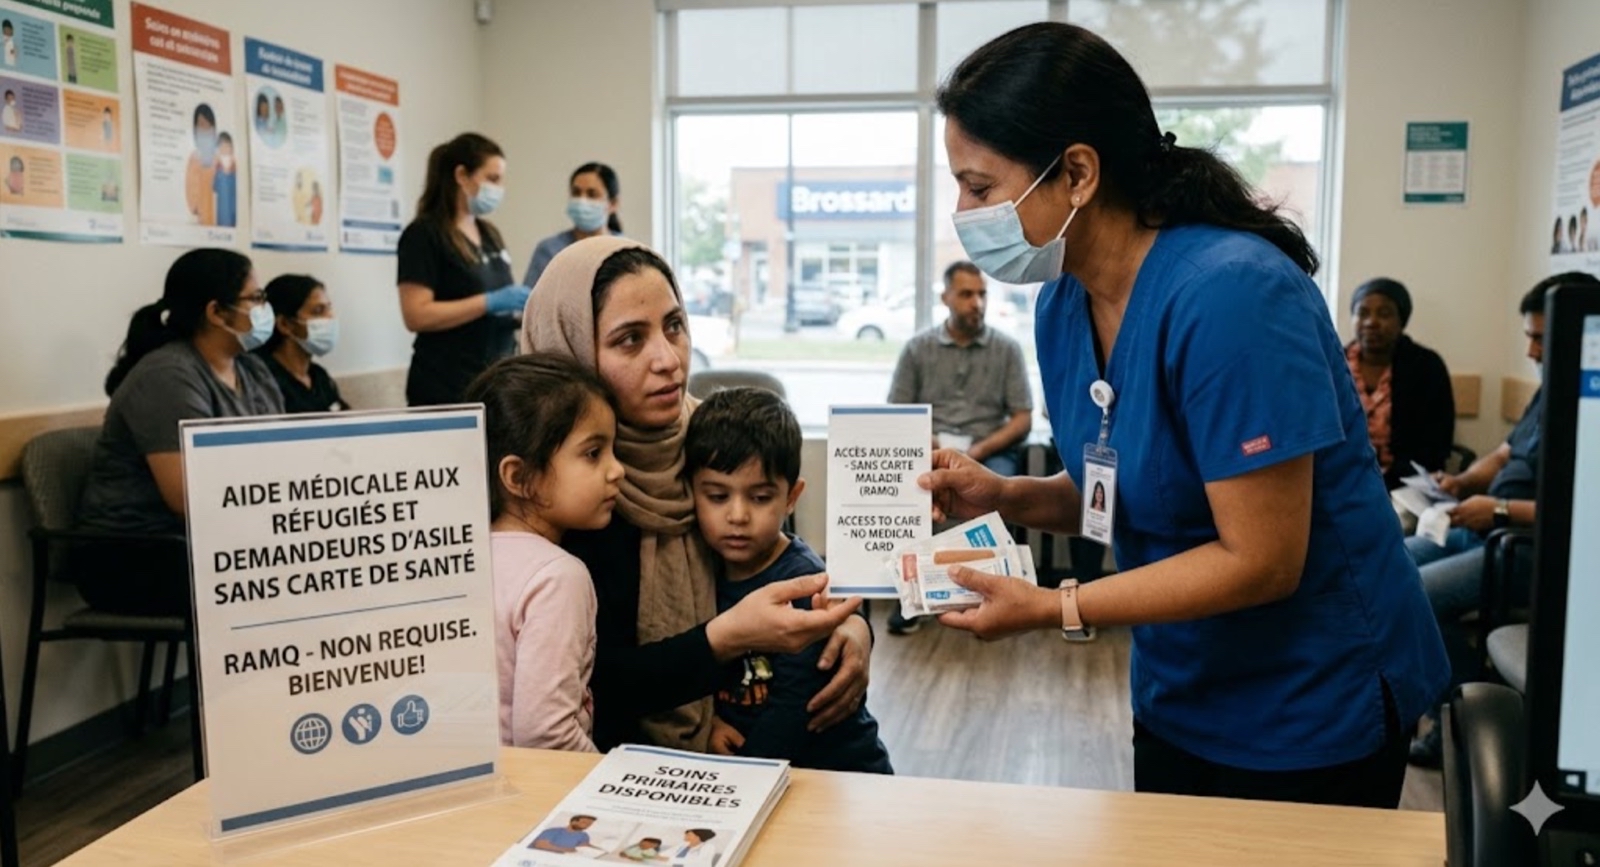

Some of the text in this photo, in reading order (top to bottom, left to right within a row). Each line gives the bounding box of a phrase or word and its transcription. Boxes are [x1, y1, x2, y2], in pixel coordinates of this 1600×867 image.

[791, 185, 916, 213] Brossard
[834, 445, 924, 458] ACCÈS AUX SOINS
[850, 460, 879, 471] SANS
[880, 460, 914, 471] CARTE
[221, 467, 460, 508] AIDE MÉDICALE AUX
[855, 473, 903, 483] MALADIE
[859, 485, 899, 497] (RAMQ)
[272, 500, 419, 534] RÉFUGIÉS ET
[837, 515, 922, 526] ACCESS TO CARE
[850, 528, 867, 538] NO
[868, 528, 916, 539] MEDICAL
[214, 524, 473, 573] DEMANDEURS D'ASILE
[864, 541, 895, 552] CARD
[214, 549, 475, 605] SANS CARTE DE SANTÉ
[224, 644, 300, 675] RAMQ
[320, 633, 372, 660] NON
[378, 618, 478, 651] REQUISE.
[289, 655, 426, 696] BIENVENUE!
[654, 765, 720, 781] SOINS
[598, 783, 742, 808] DISPONIBLES
